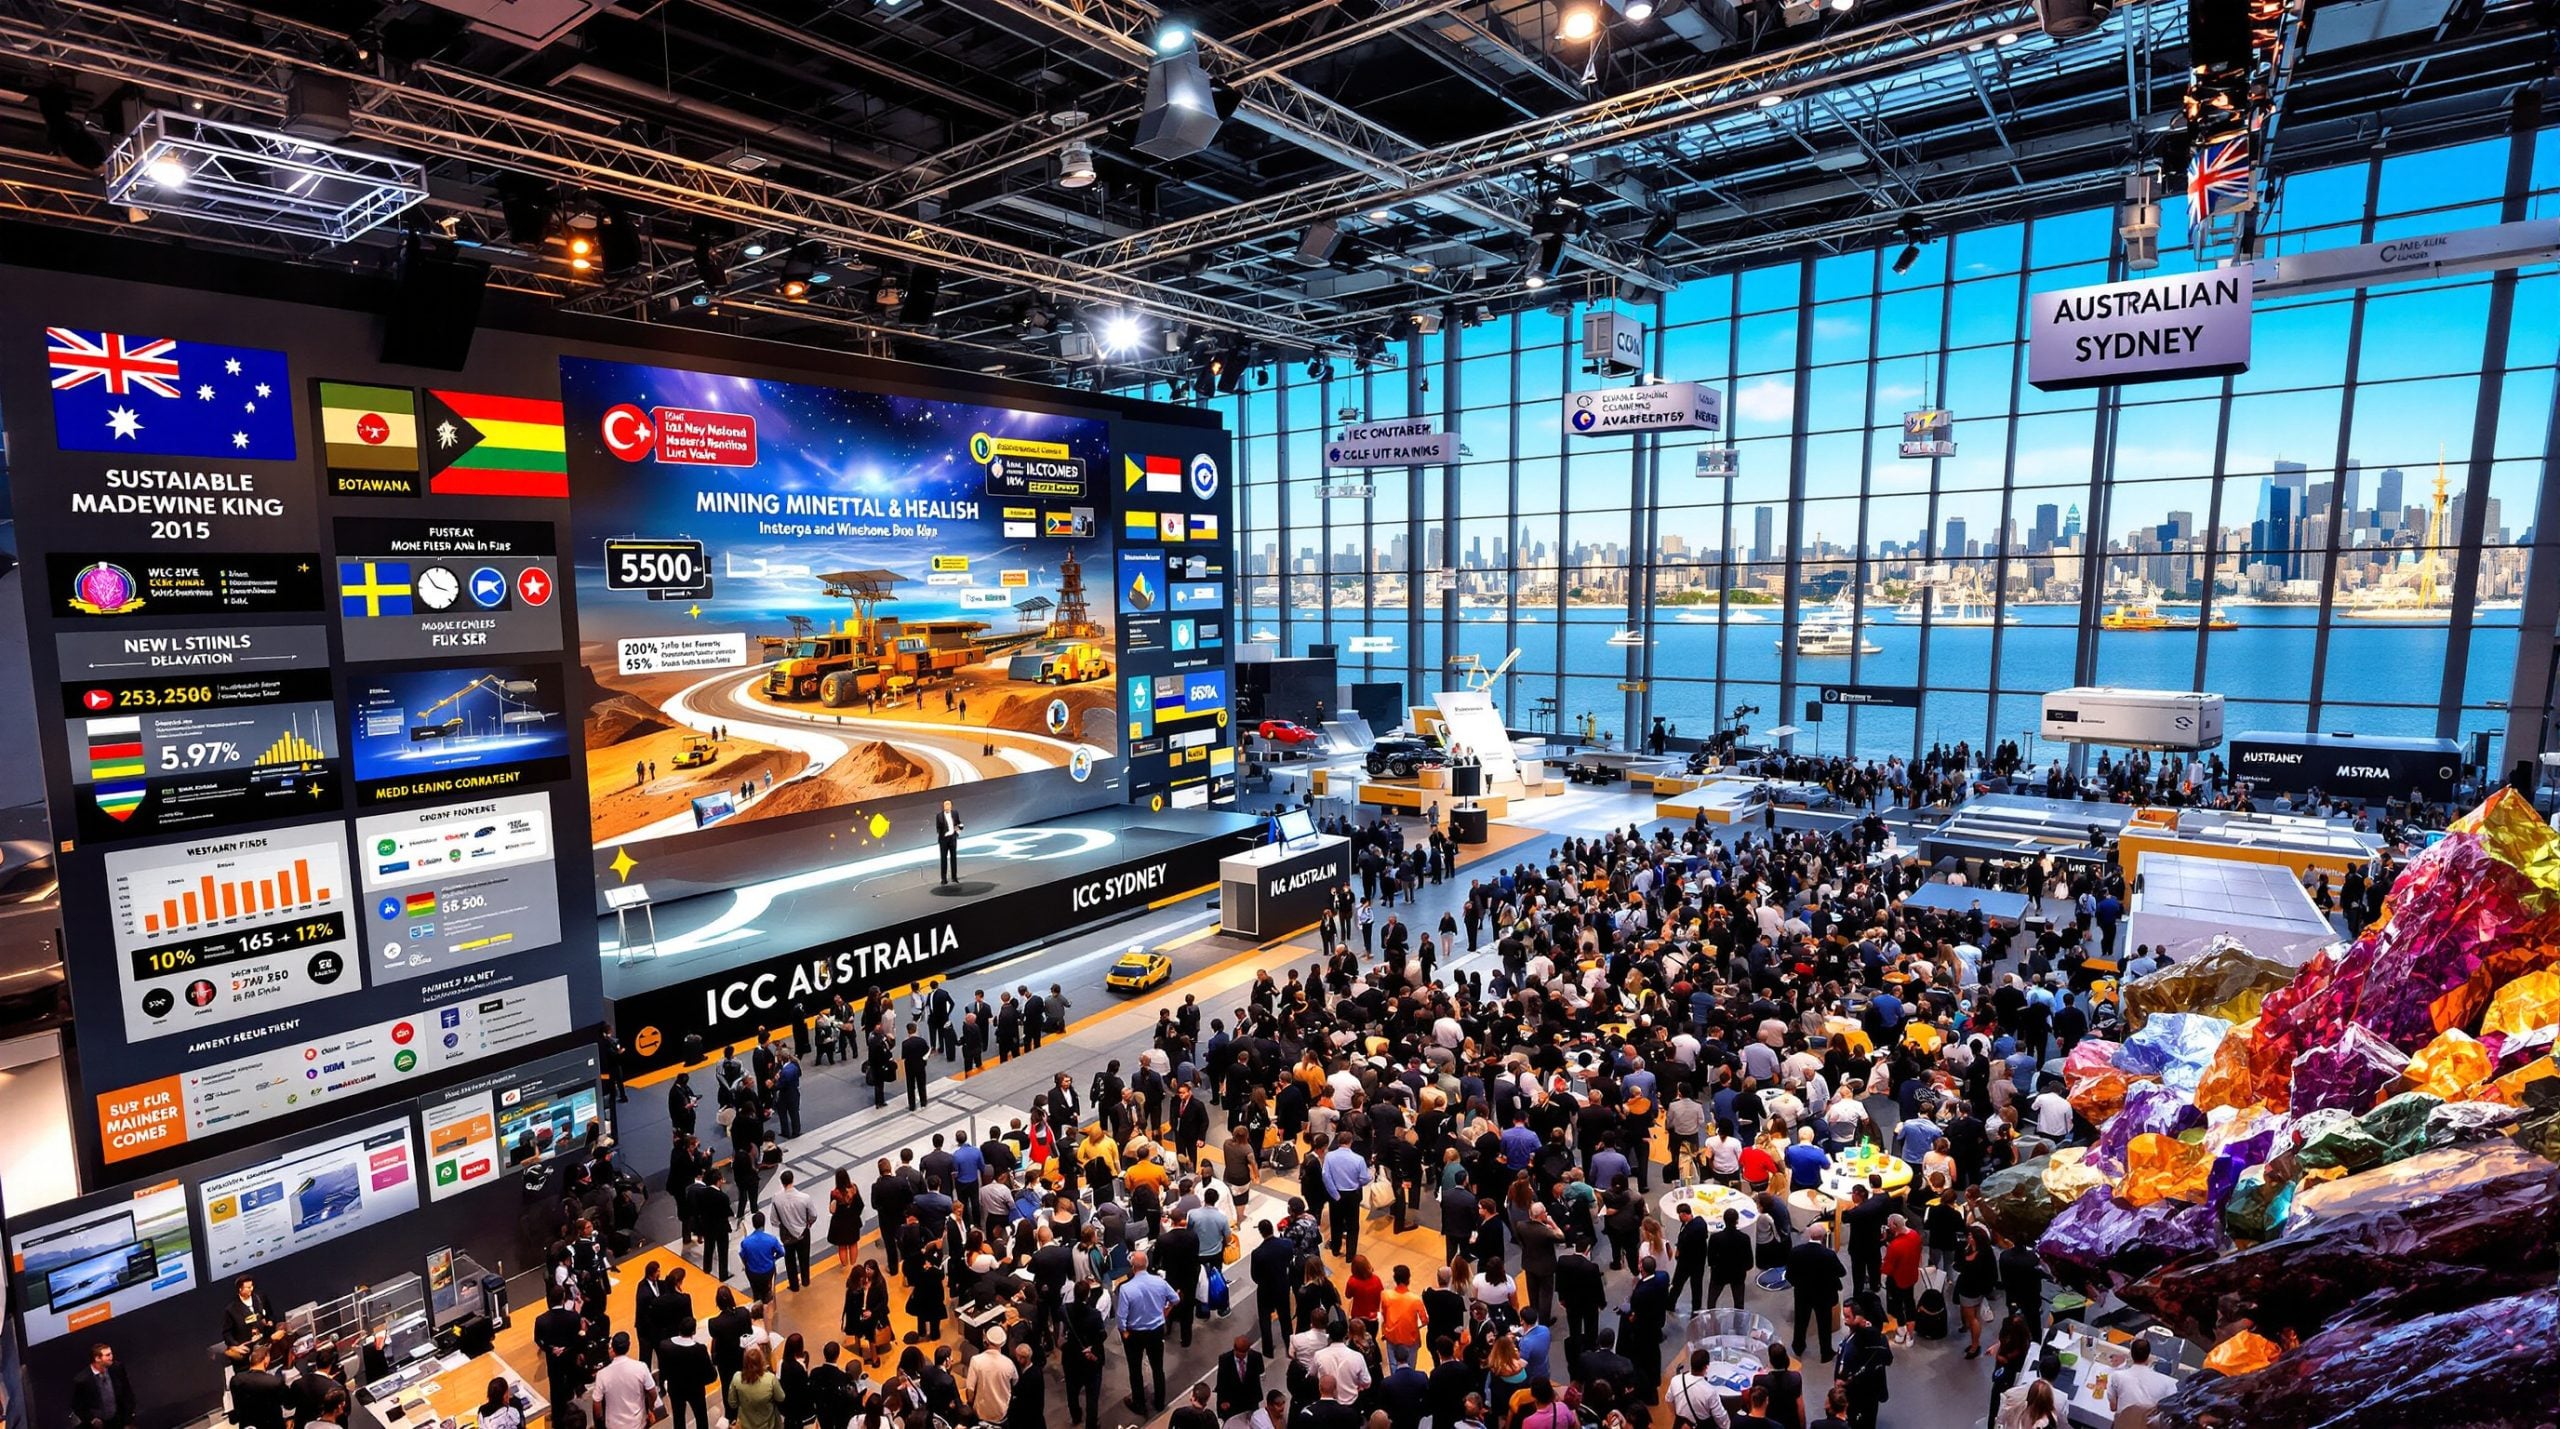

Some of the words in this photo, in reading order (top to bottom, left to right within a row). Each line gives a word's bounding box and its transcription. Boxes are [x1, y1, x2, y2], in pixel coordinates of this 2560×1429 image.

[2053, 277, 2239, 325] AUSTRALIAN
[2075, 325, 2204, 363] SYDNEY
[106, 468, 254, 493] SUSTAIABLE
[338, 478, 411, 492] BOTAWANA
[71, 492, 217, 515] MADEWINE
[221, 494, 284, 516] KING
[696, 491, 780, 515] MINING
[786, 494, 885, 518] MINETTAL
[888, 499, 902, 518] &
[905, 499, 980, 520] HEALISH
[150, 520, 210, 540] 2015
[813, 523, 834, 536] and
[620, 552, 693, 583] 5500
[124, 637, 168, 653] NEW
[624, 641, 658, 656] 200%
[151, 652, 233, 667] DELAVATION
[160, 741, 241, 770] 5.97%
[376, 786, 409, 800] MEDD
[1073, 882, 1101, 912] ICC
[1105, 863, 1167, 901] SYDNEY
[238, 931, 274, 953] 165
[149, 948, 196, 972] 10%
[706, 974, 778, 1026] ICC
[787, 923, 960, 1001] AUSTRALIA
